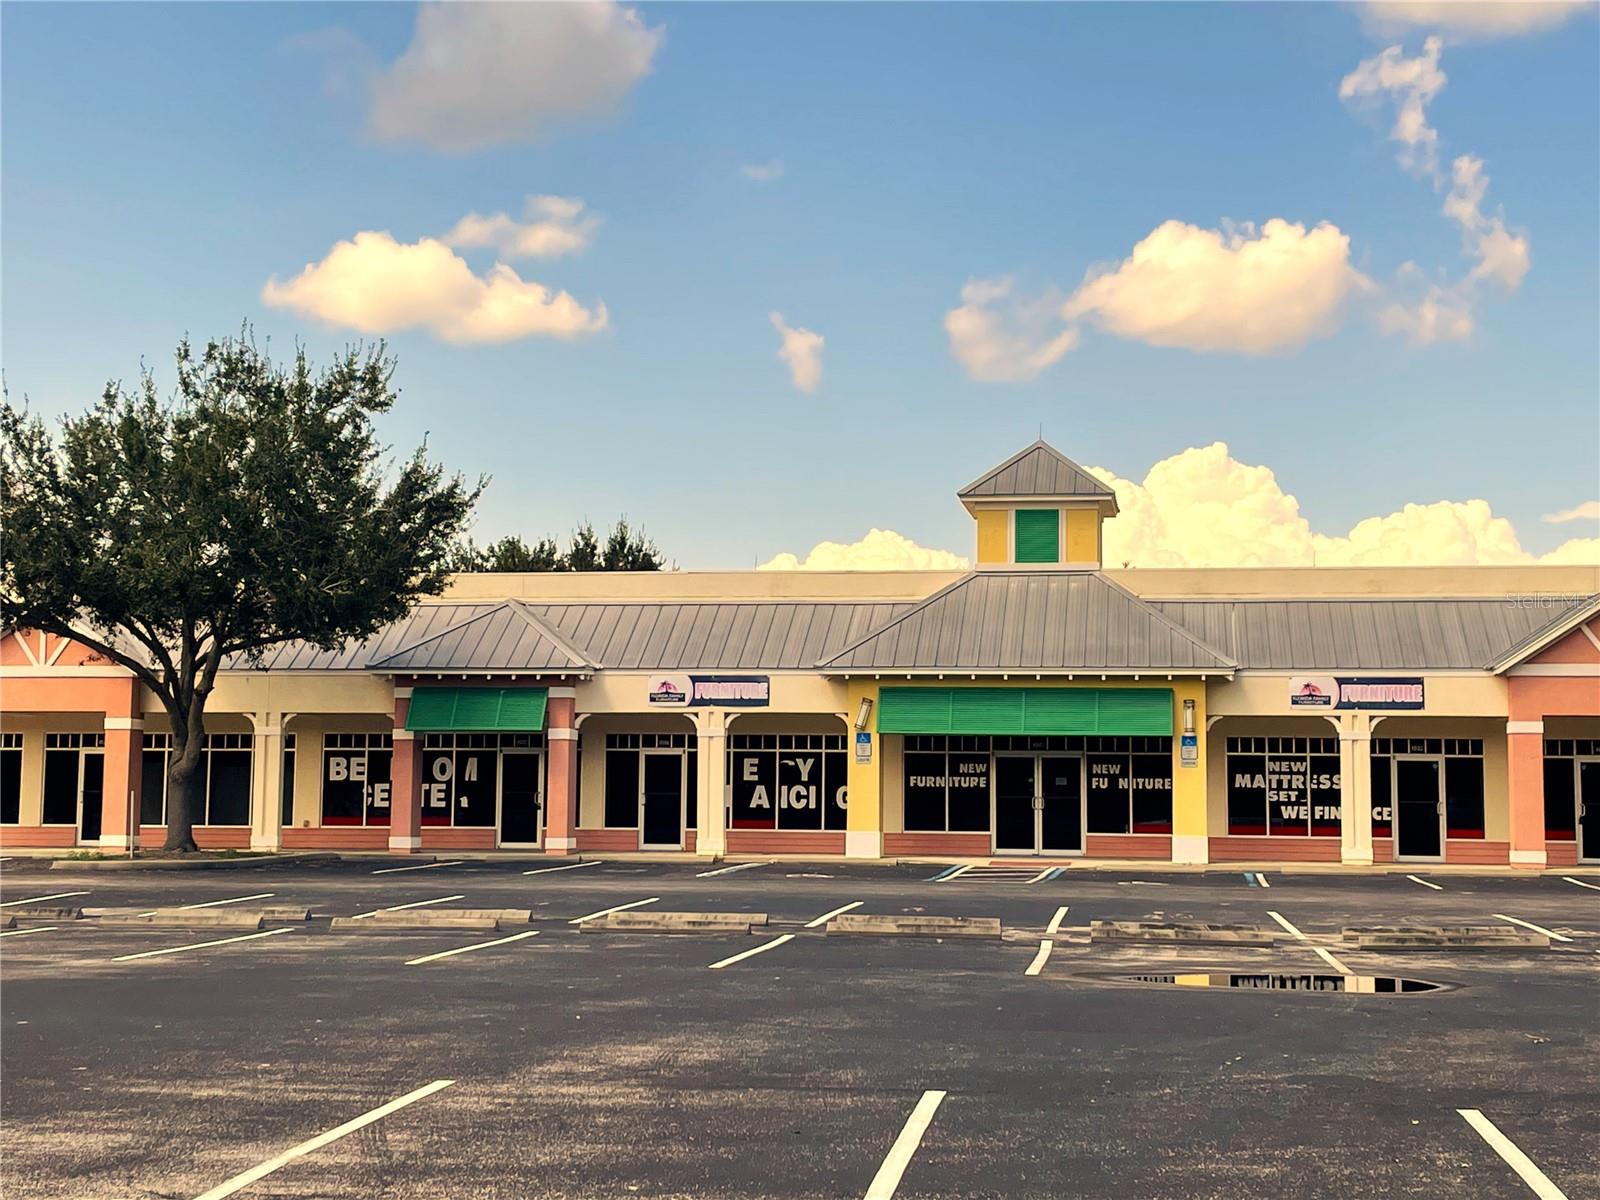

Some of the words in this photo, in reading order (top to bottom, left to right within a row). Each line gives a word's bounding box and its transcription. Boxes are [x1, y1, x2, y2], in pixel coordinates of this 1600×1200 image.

[694, 682, 768, 699] FURNITURE
[1341, 684, 1422, 702] FURNITURE
[960, 763, 987, 773] NEW
[1092, 764, 1121, 774] NEW
[1268, 762, 1306, 772] NEW
[910, 776, 987, 788] FURNITURE
[1281, 806, 1308, 819] WE
